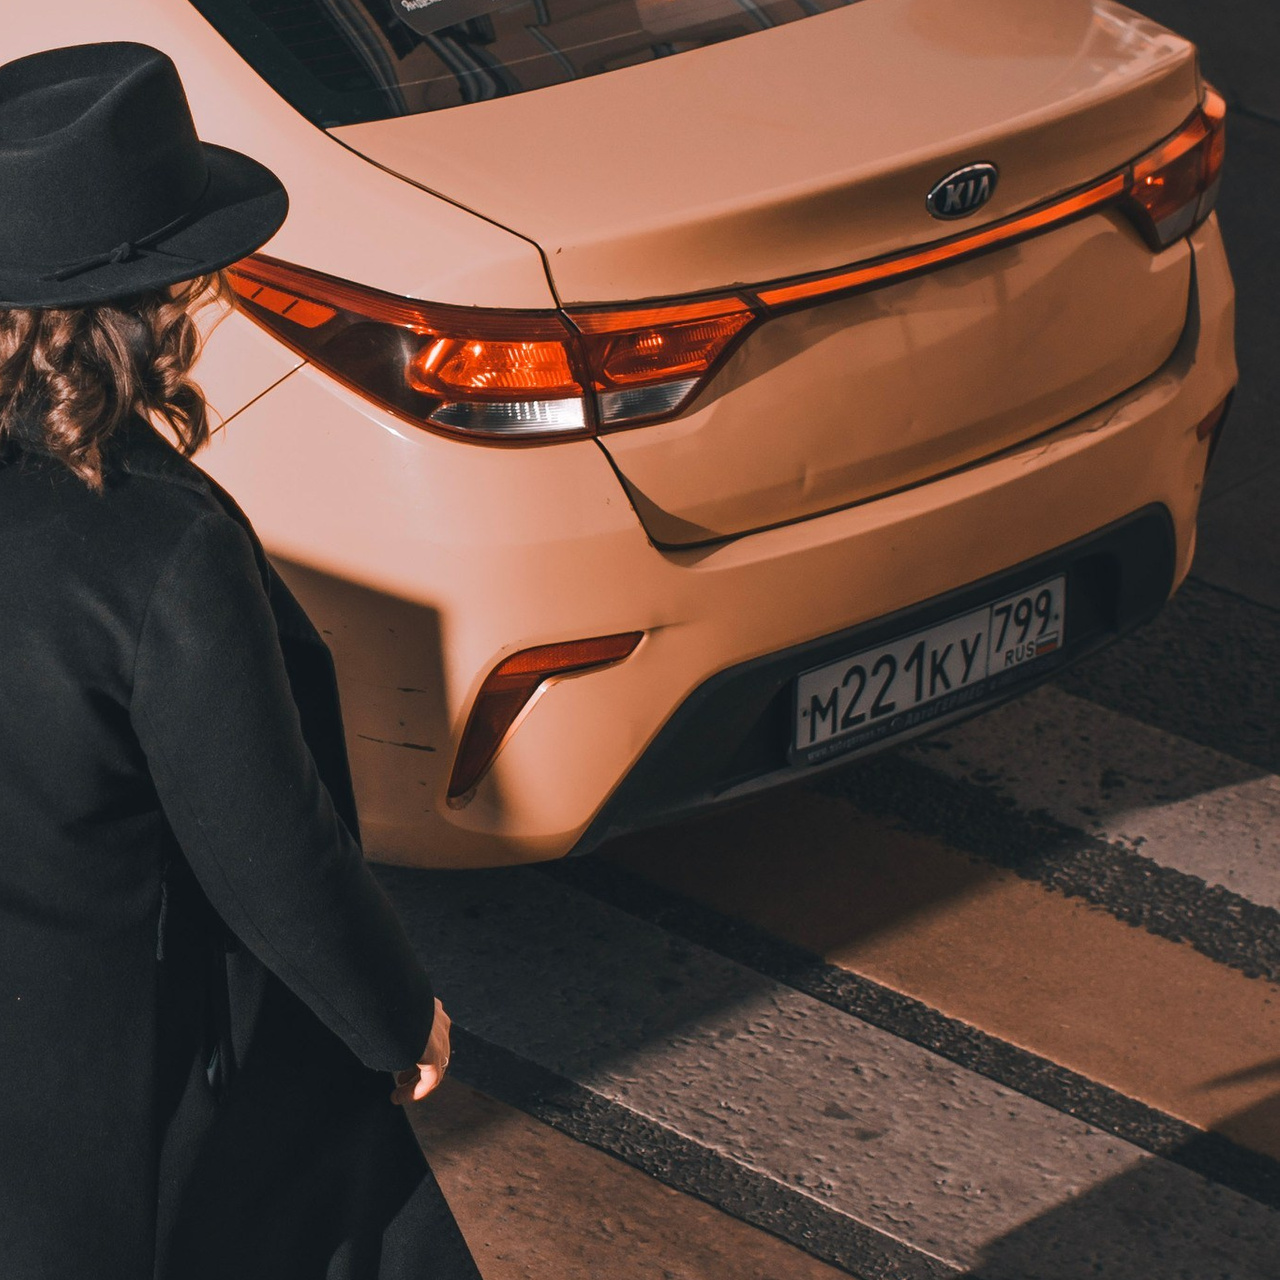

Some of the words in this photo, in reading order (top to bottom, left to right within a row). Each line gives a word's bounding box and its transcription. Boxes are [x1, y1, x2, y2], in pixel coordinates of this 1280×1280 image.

[943, 174, 990, 213] KIA
[994, 588, 1053, 654] 799
[1004, 640, 1036, 668] RUS
